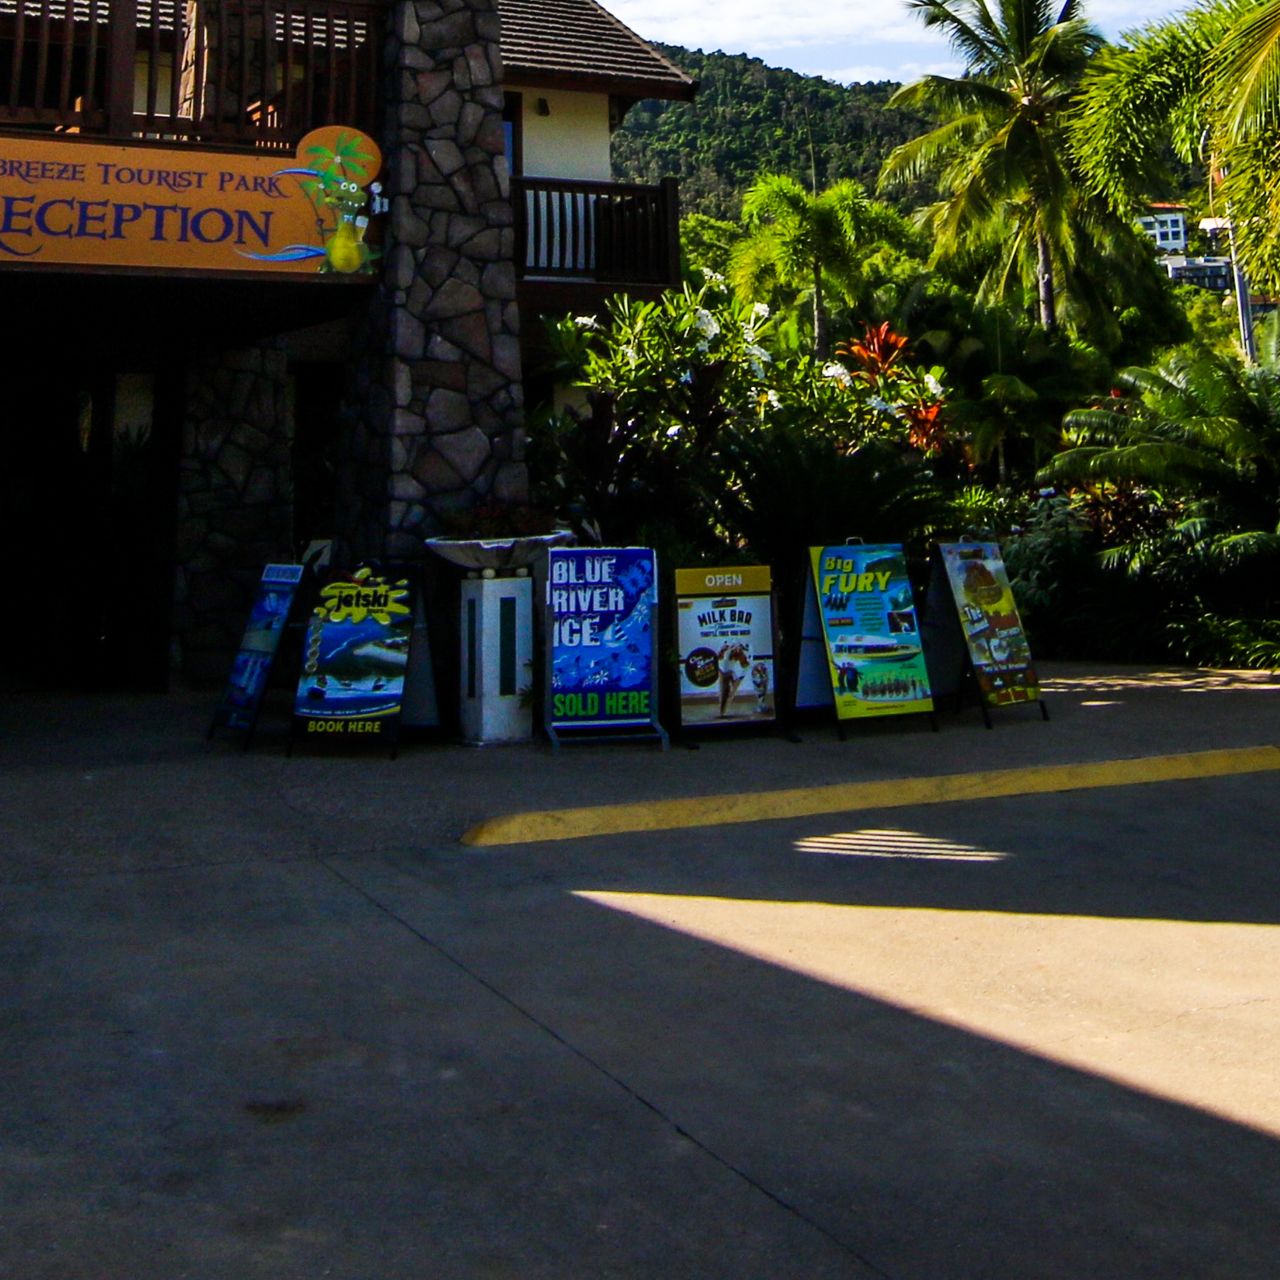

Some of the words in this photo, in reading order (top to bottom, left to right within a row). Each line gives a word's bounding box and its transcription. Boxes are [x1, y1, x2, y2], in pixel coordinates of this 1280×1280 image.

[96, 162, 205, 192] TOURIST
[217, 171, 292, 198] PARK
[553, 556, 616, 584] BLUE
[824, 557, 853, 572] Big
[705, 574, 742, 587] OPEN
[822, 571, 891, 594] FURY
[336, 590, 388, 612] jetski
[553, 585, 625, 612] RIVER
[697, 610, 727, 627] MILK
[730, 609, 753, 624] BAR
[553, 613, 601, 647] ICE
[553, 692, 599, 717] SOLD
[605, 691, 650, 715] HERE
[307, 720, 345, 733] BOOK
[347, 720, 382, 733] HERE
